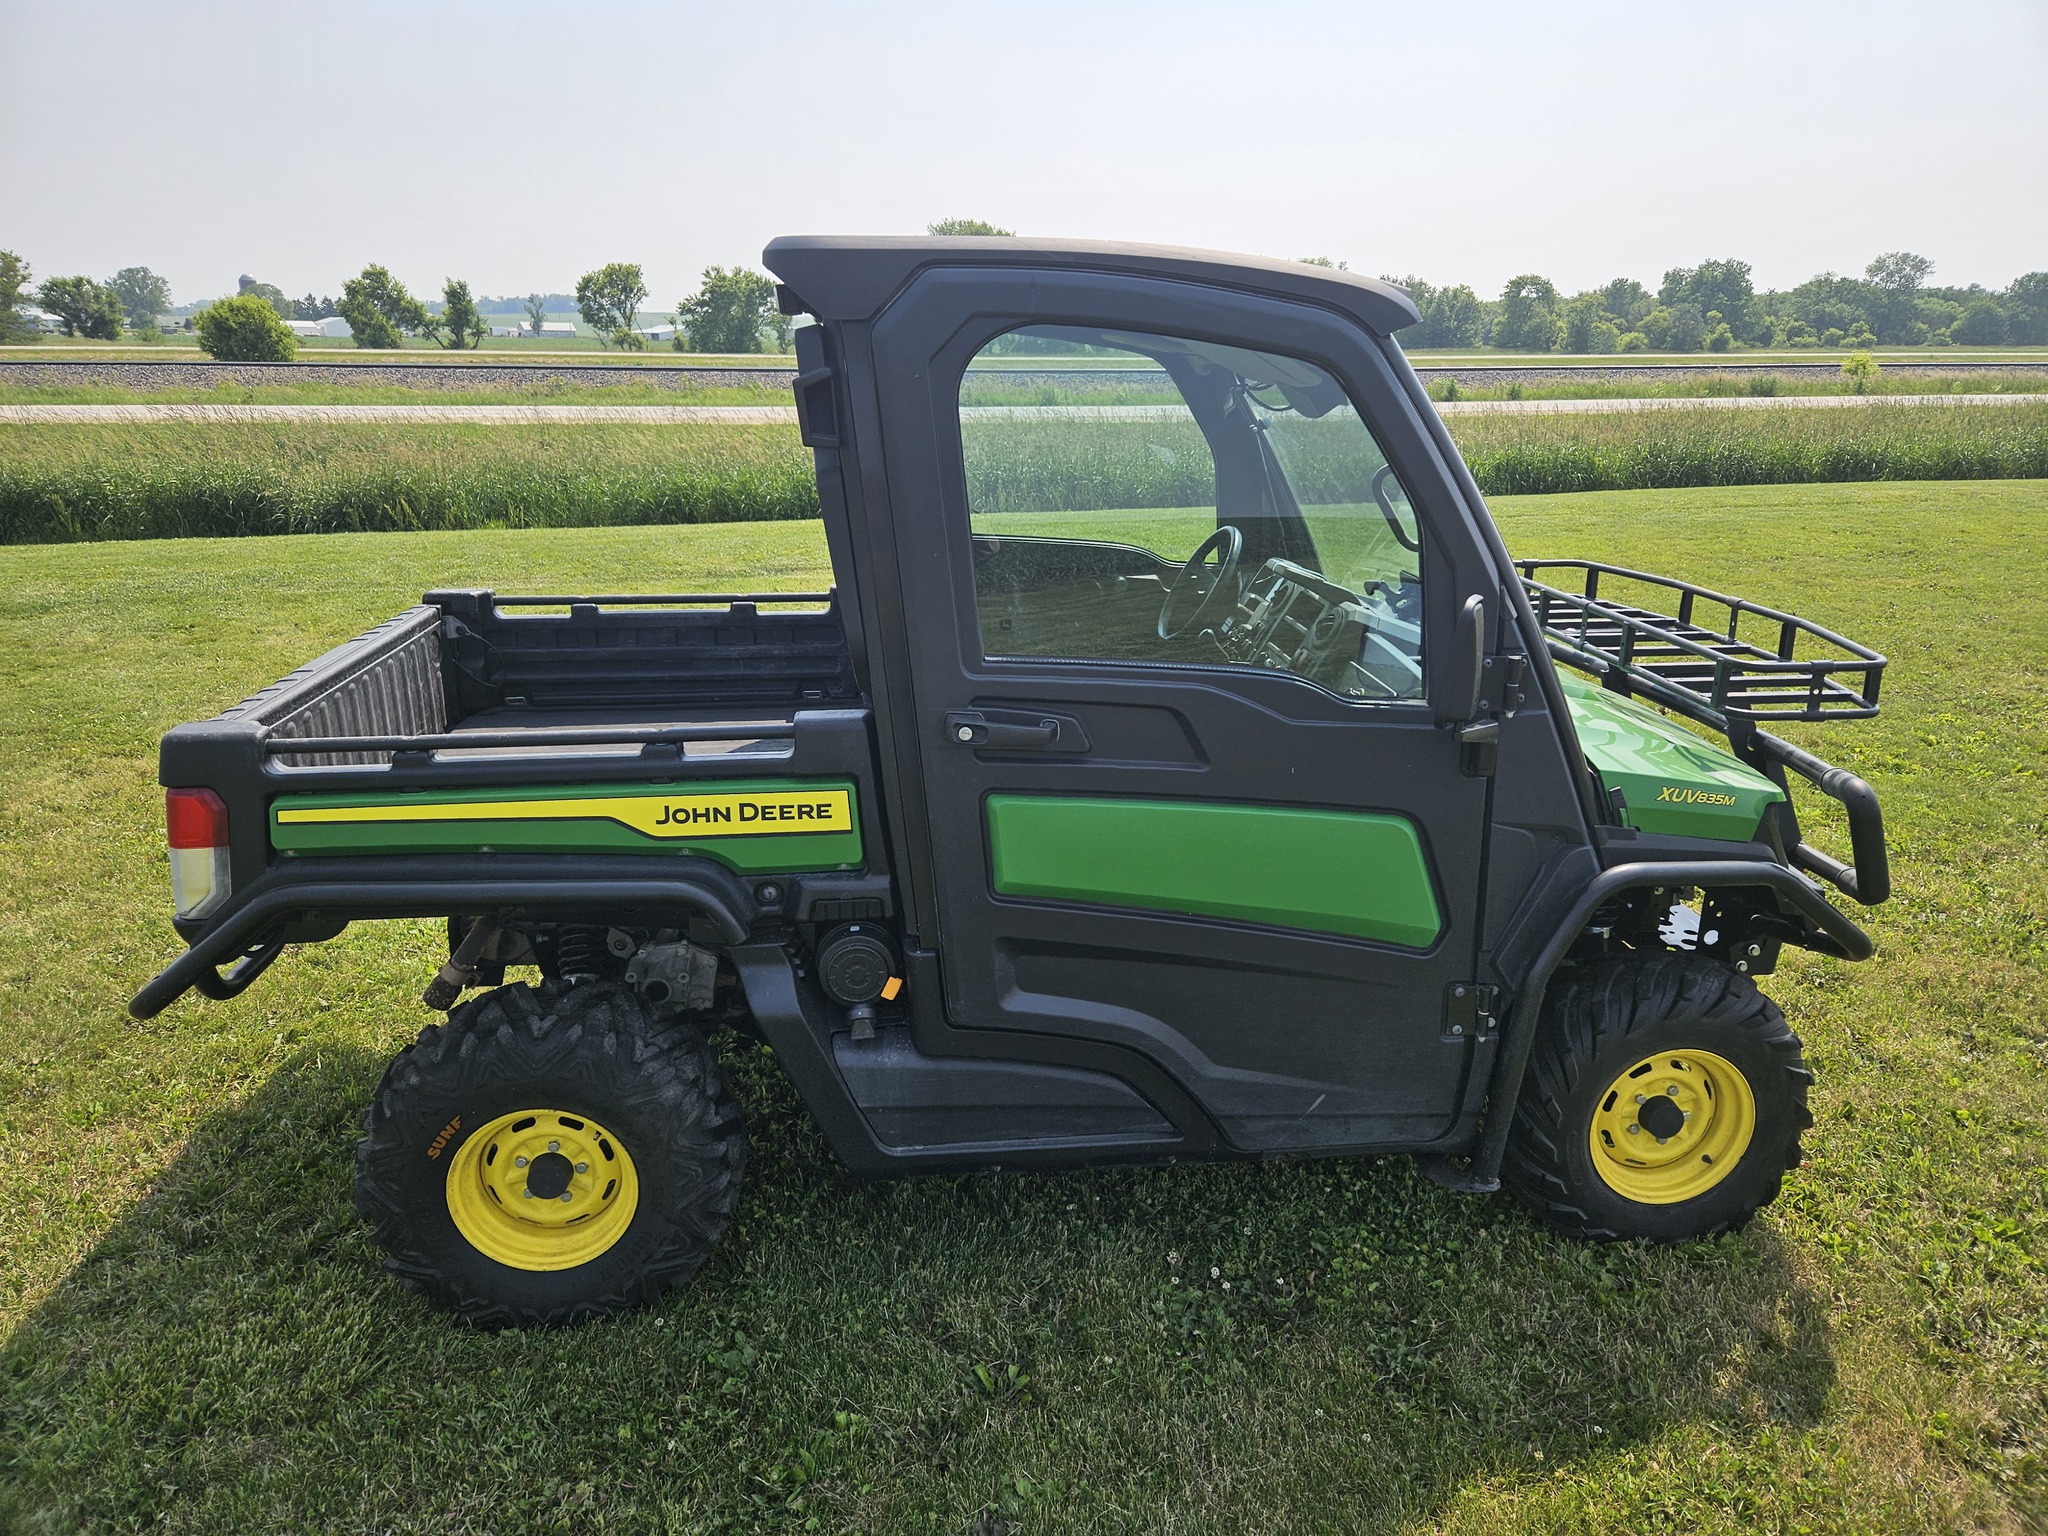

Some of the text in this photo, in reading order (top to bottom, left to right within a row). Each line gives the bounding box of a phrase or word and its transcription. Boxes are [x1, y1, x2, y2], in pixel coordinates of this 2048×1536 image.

[1656, 786, 1736, 807] XUV835M
[656, 803, 832, 825] JOHN DEERE
[427, 1114, 461, 1160] SUNF
